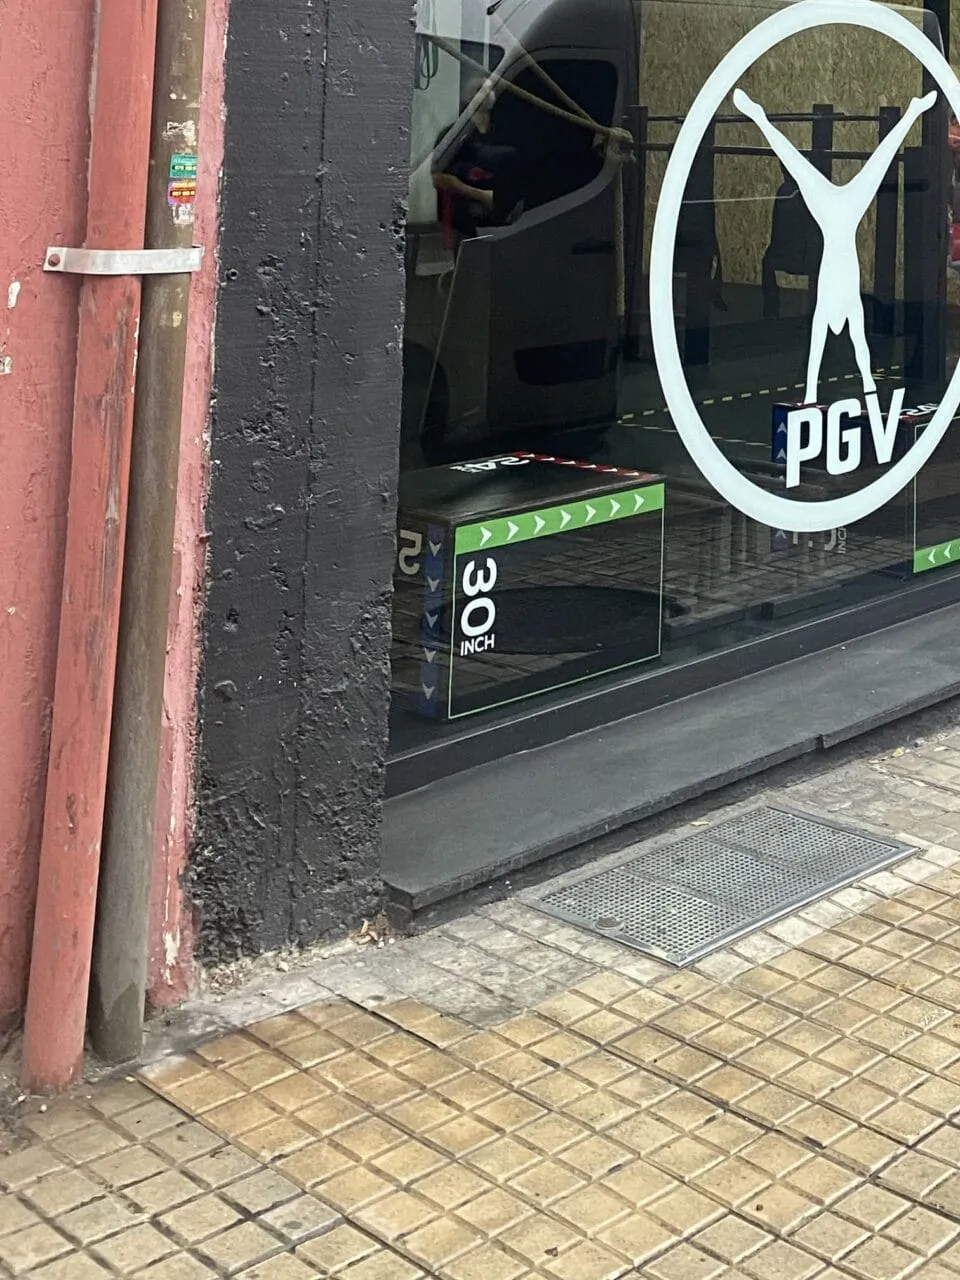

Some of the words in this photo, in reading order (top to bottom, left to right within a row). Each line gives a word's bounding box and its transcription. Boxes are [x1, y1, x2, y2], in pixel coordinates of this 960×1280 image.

[786, 387, 906, 489] PGV
[460, 557, 498, 637] 30
[459, 633, 495, 657] INCH
